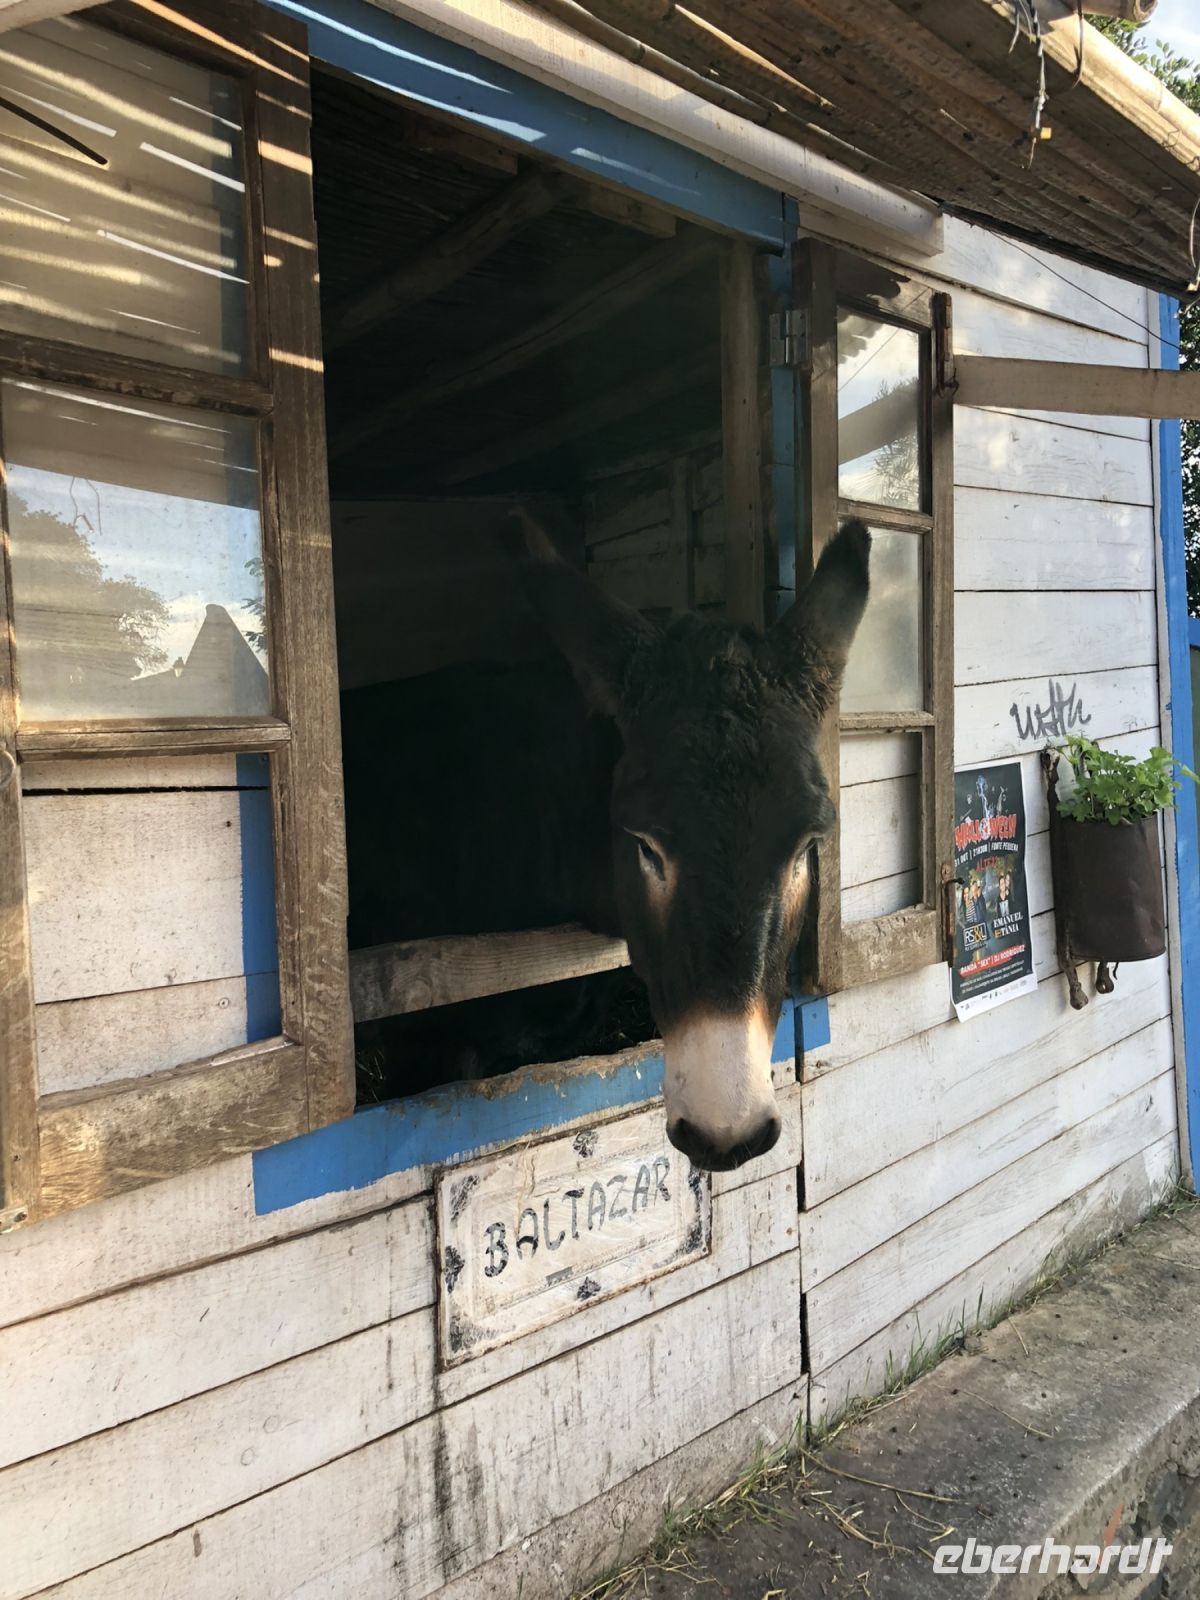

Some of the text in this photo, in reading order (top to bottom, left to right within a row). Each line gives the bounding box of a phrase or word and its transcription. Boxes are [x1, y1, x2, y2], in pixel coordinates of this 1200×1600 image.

[960, 852, 969, 863] OUT
[991, 841, 1003, 851] FONTE
[993, 912, 1024, 928] EMANUEL
[960, 963, 977, 974] BANDA
[483, 1156, 671, 1278] BALTAZAR
